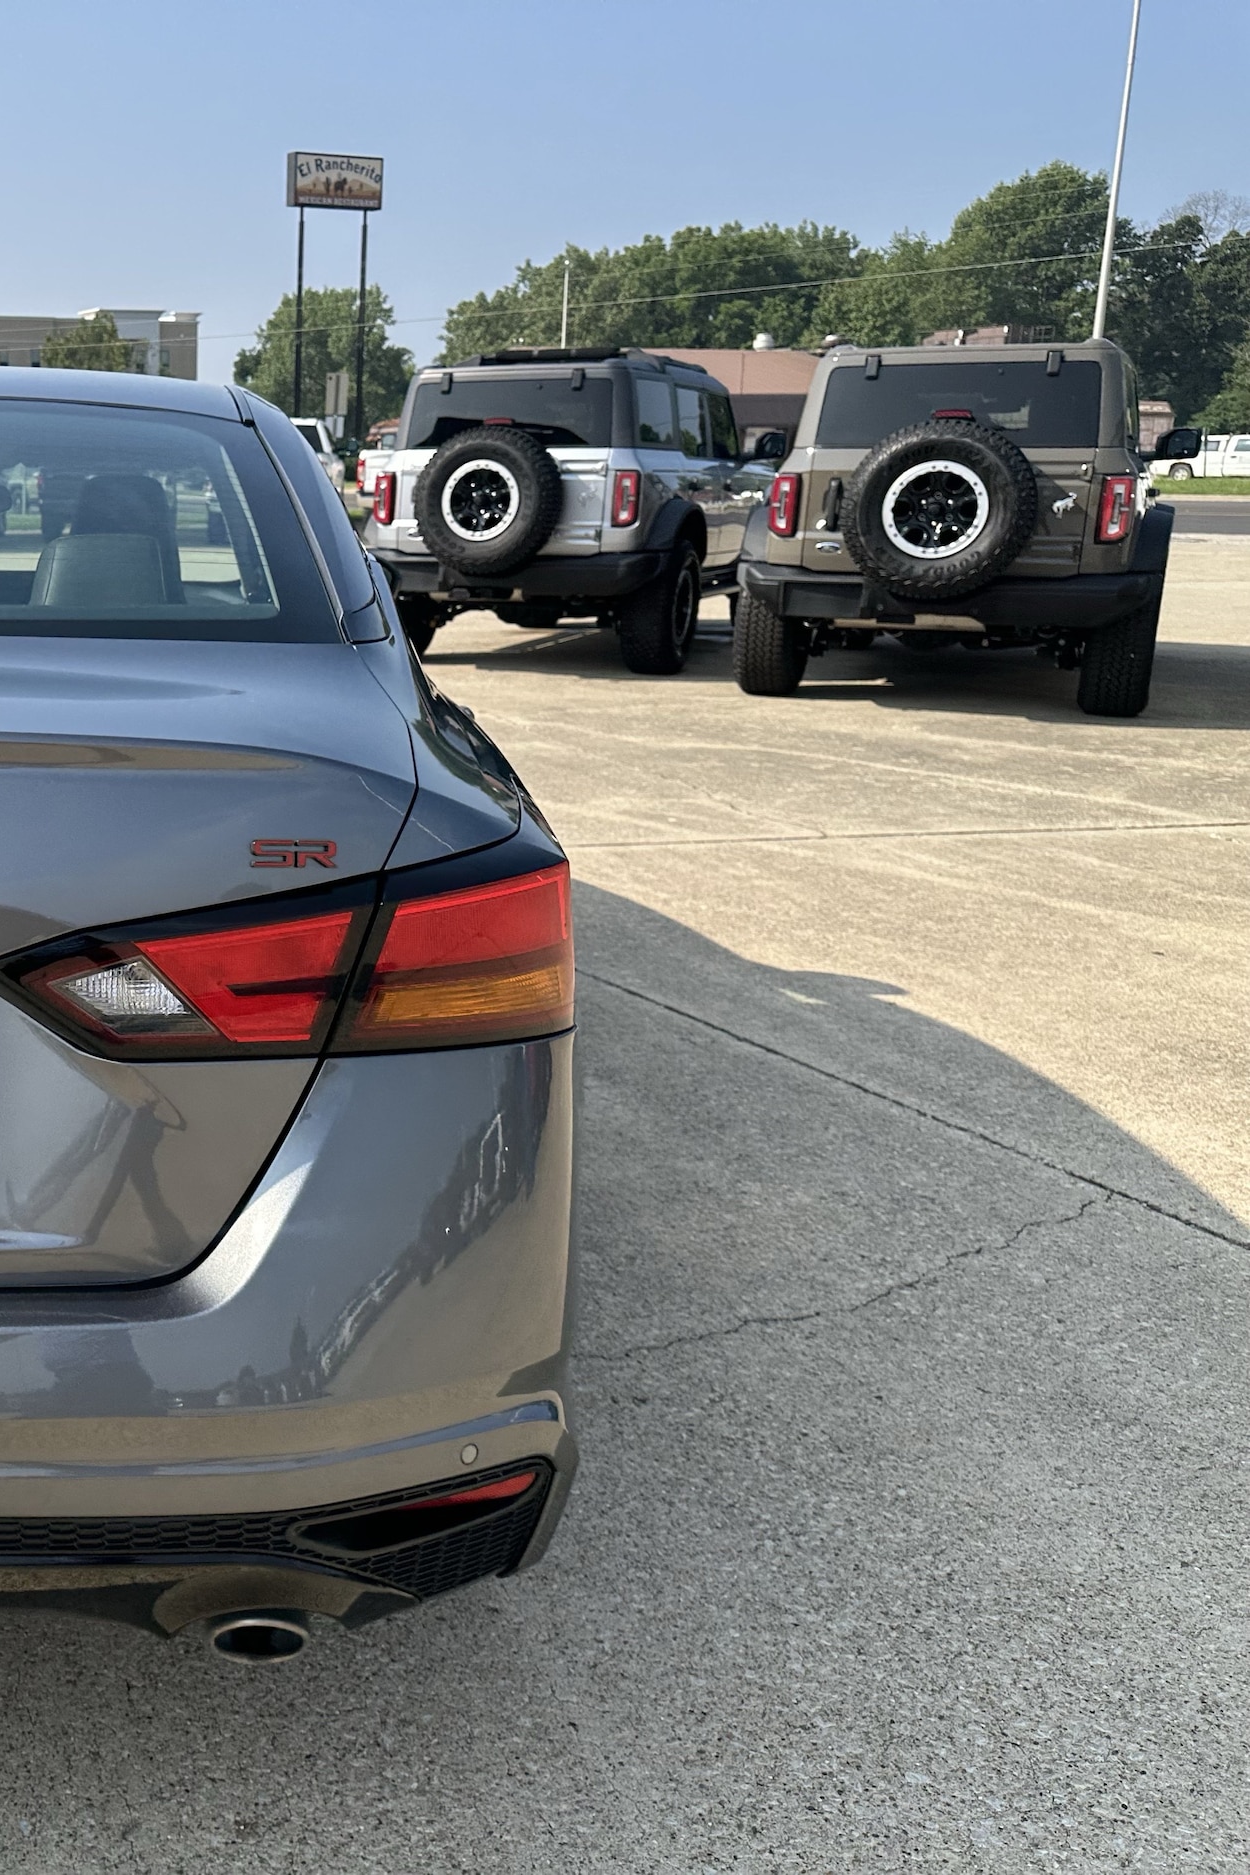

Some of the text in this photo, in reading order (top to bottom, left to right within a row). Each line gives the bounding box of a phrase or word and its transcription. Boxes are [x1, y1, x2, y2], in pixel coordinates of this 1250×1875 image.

[297, 157, 383, 184] El Rancherito
[250, 839, 337, 868] SR
